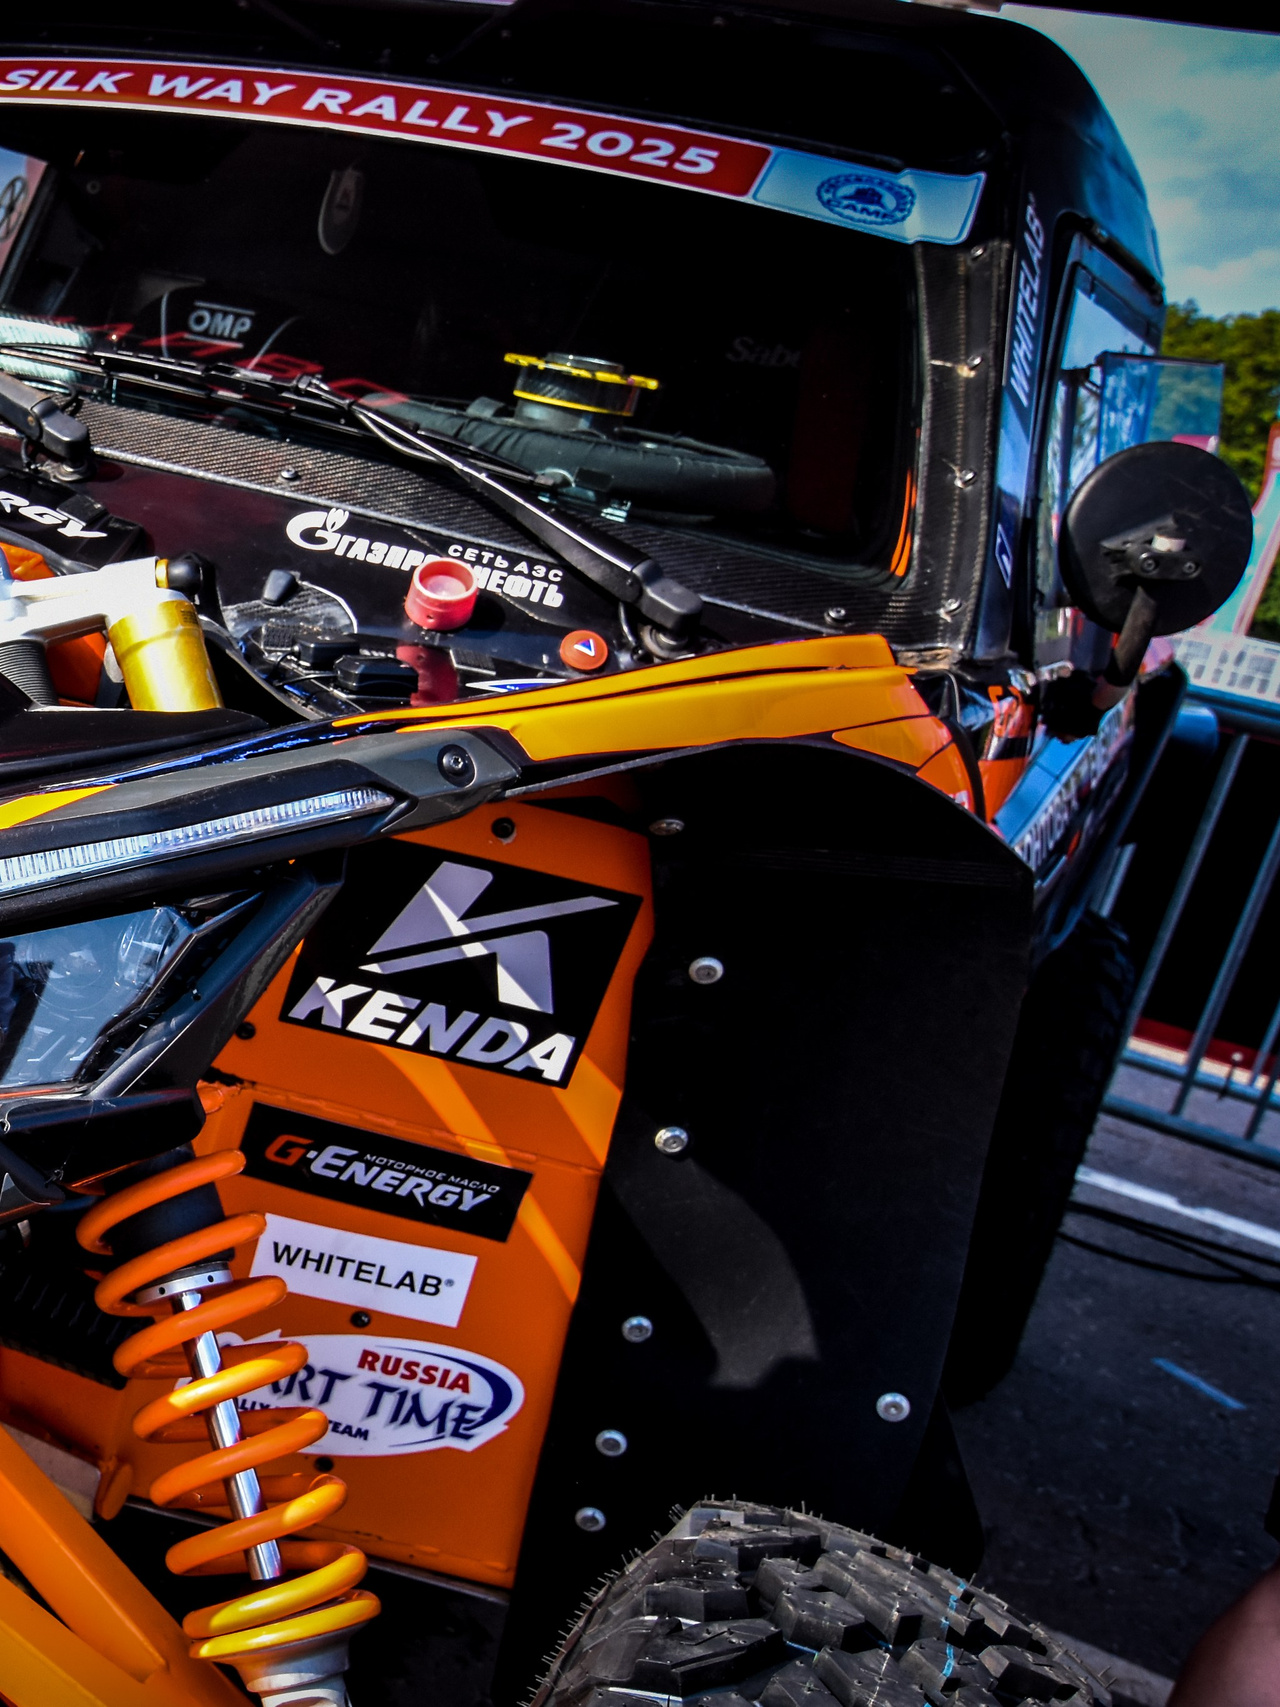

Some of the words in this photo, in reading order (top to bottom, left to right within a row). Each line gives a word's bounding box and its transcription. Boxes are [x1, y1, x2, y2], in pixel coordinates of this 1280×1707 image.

[147, 73, 297, 106] WAY
[302, 87, 533, 138] RALLY
[540, 122, 720, 175] 2025
[187, 309, 254, 340] OMP
[334, 533, 564, 608] ГАЗПРНЕФТЬ
[447, 544, 510, 568] СЕТЬ
[513, 561, 564, 582] АЗС
[287, 976, 577, 1082] KENDA
[363, 1153, 446, 1181] МОТОРНОЕ
[448, 1175, 500, 1194] МАСЛО
[357, 1349, 471, 1395] RUSSIA
[363, 1381, 490, 1440] TIME
